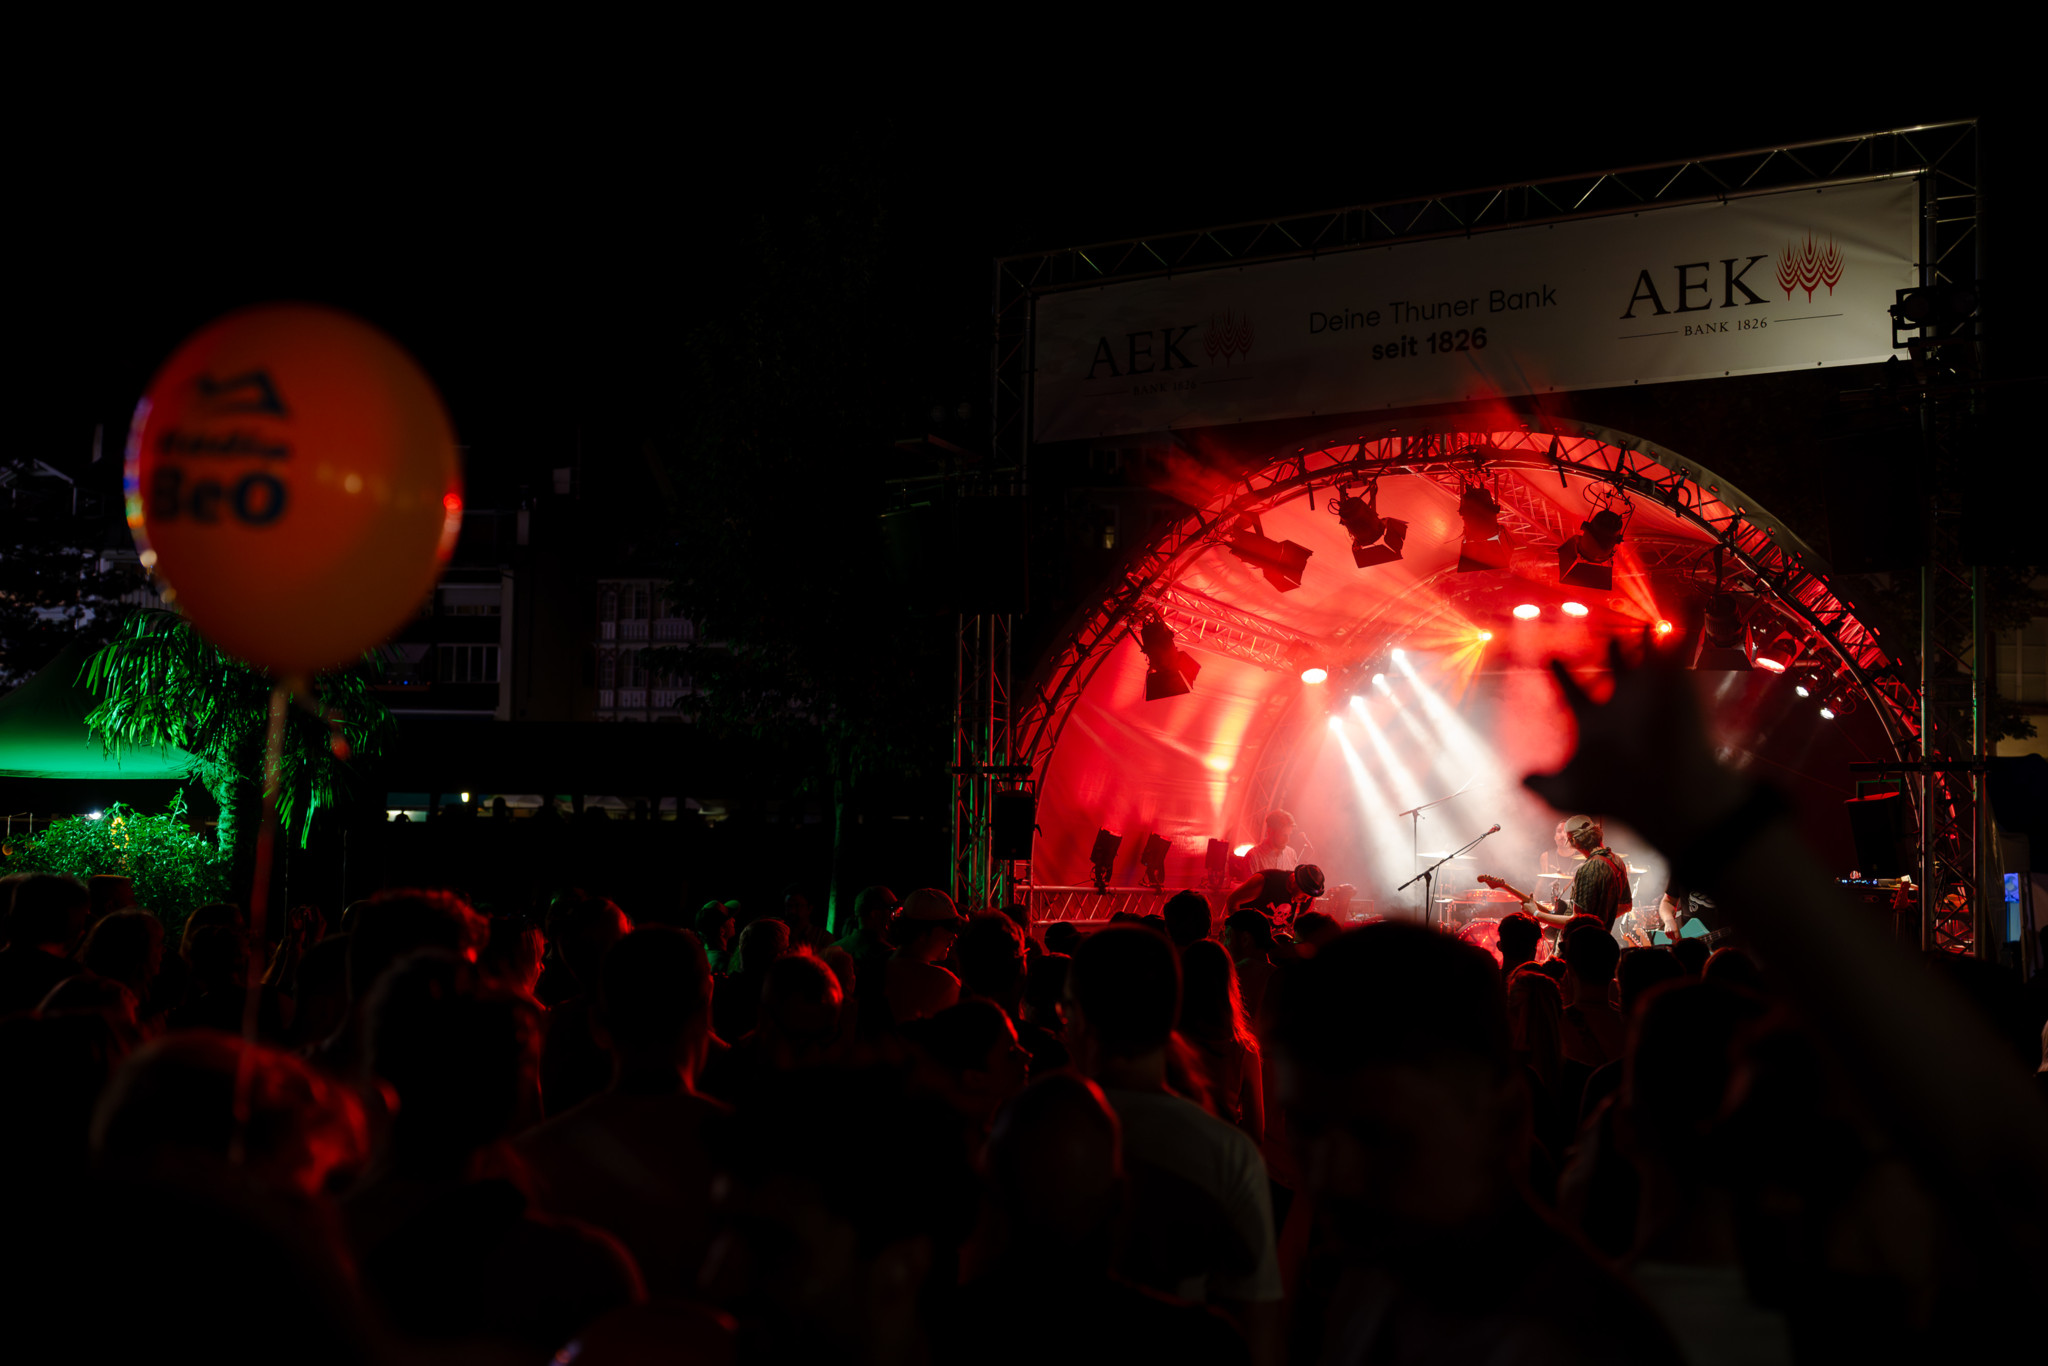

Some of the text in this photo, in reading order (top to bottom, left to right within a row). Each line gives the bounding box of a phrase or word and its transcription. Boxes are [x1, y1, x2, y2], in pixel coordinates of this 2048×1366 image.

[1309, 284, 1557, 334] Deine Thuner Bank
[1619, 255, 1771, 319] AEK
[1371, 327, 1487, 360] seit 1826
[1684, 317, 1768, 337] BANK 1826
[1084, 325, 1198, 380] AEK
